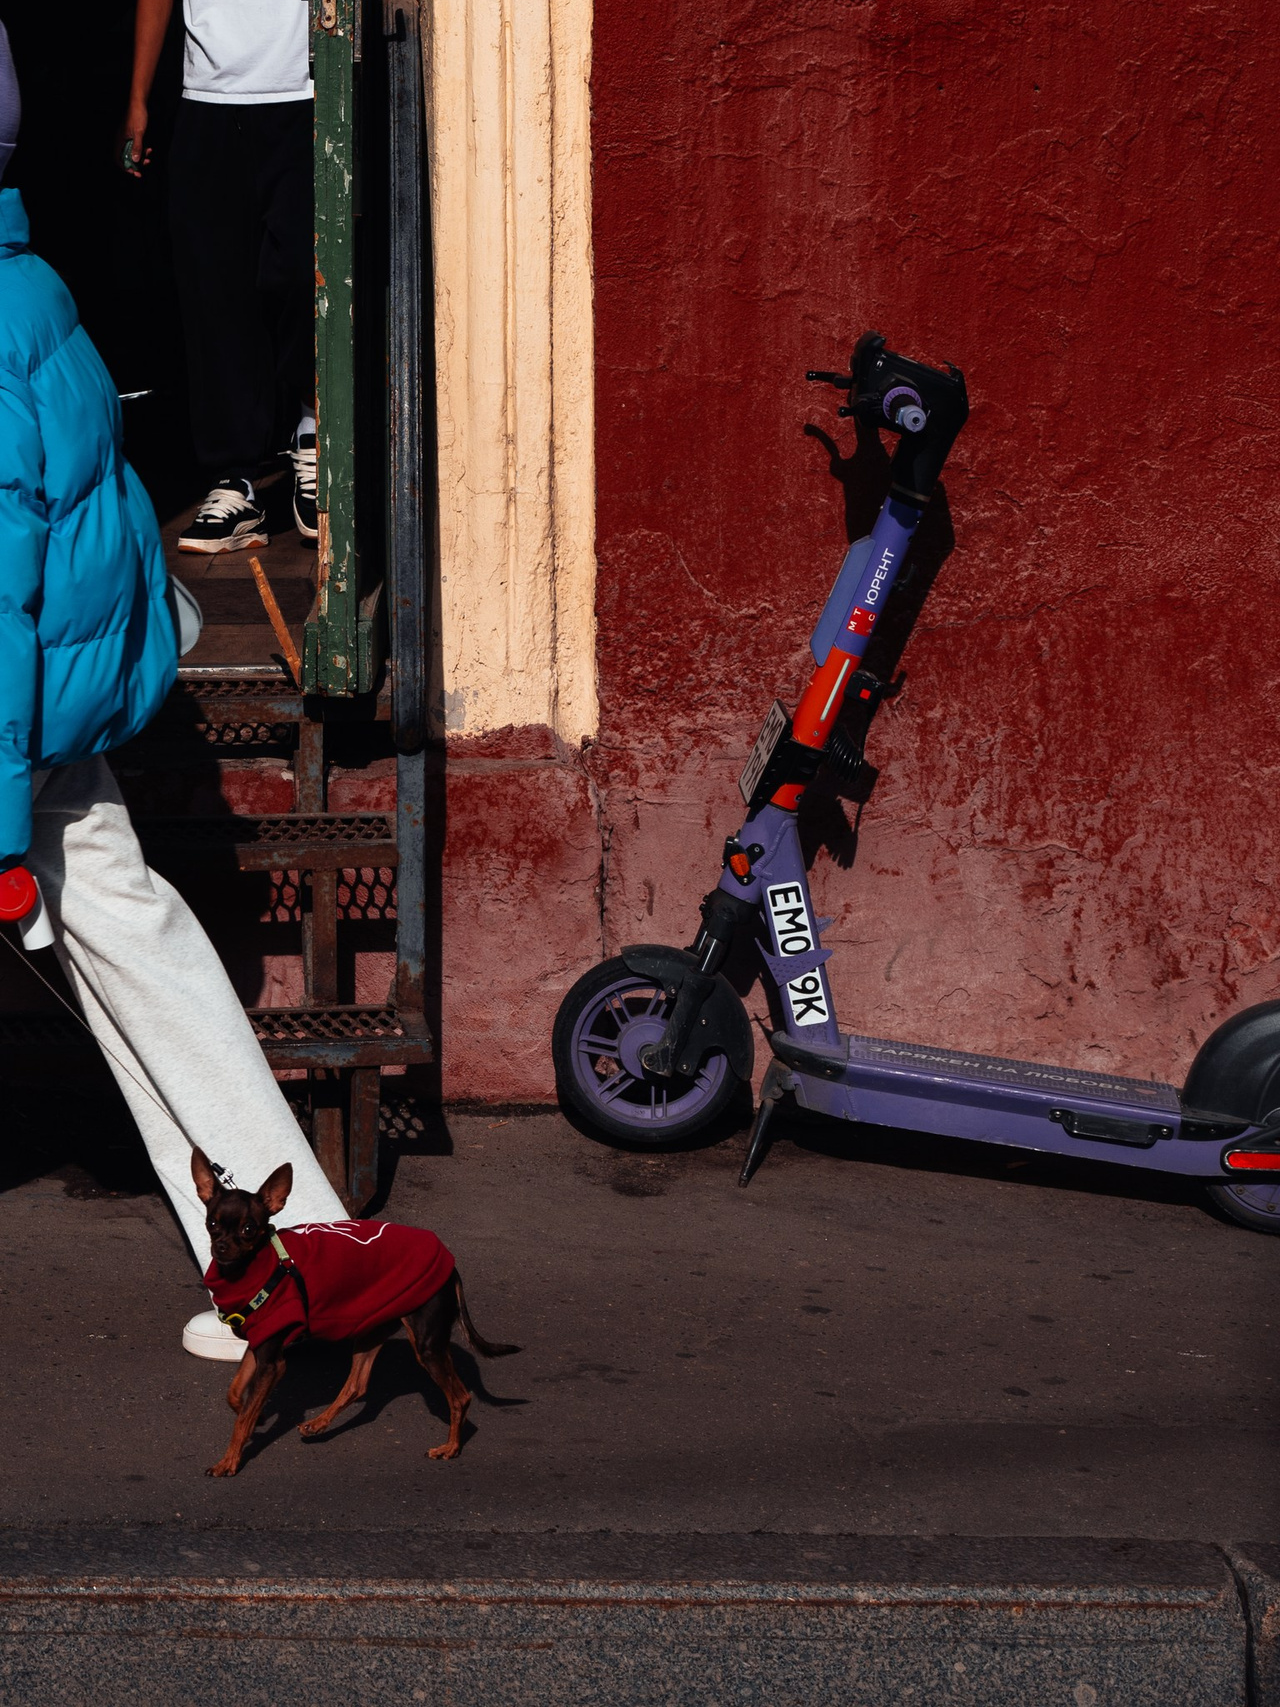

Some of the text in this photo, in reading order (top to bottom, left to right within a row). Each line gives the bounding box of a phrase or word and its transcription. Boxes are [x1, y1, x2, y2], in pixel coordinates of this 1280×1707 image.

[865, 548, 894, 605] ЮРЕНТ
[868, 1047, 1128, 1092] ЗАРЯЖЕН НА ЛЮБОВЬ
